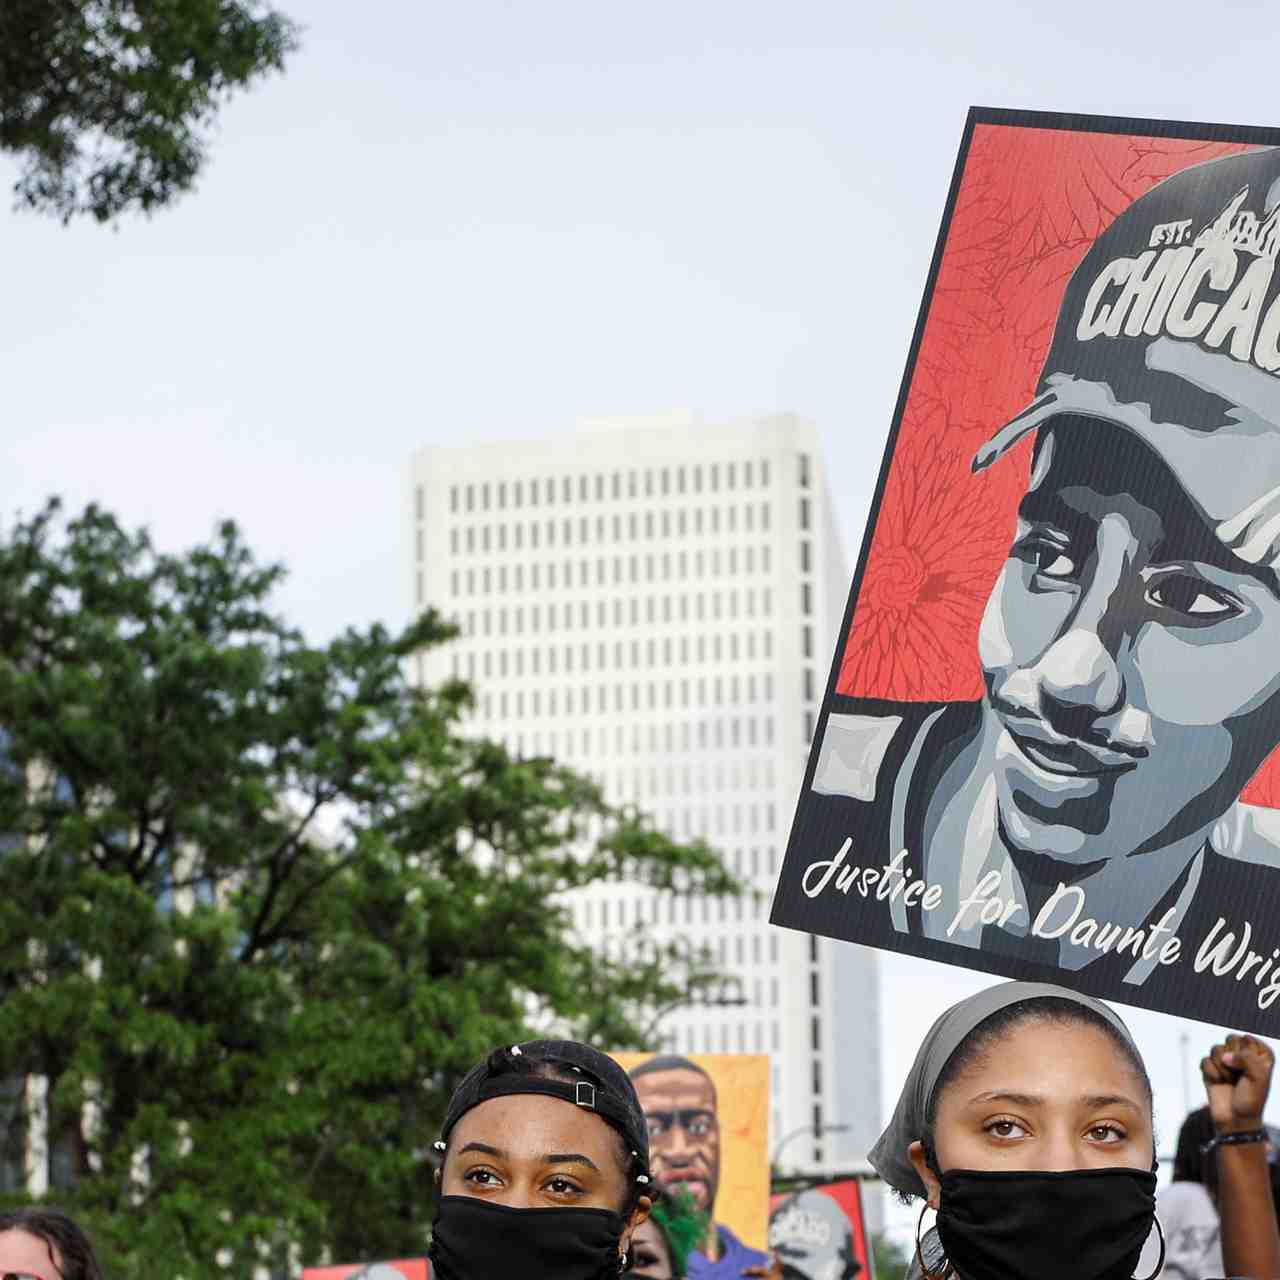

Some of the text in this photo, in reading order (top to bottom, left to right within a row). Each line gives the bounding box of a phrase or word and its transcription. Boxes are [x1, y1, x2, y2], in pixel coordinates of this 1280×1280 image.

[801, 836, 943, 911] Justice
[946, 870, 1023, 938] for
[1031, 881, 1183, 966] Daunte
